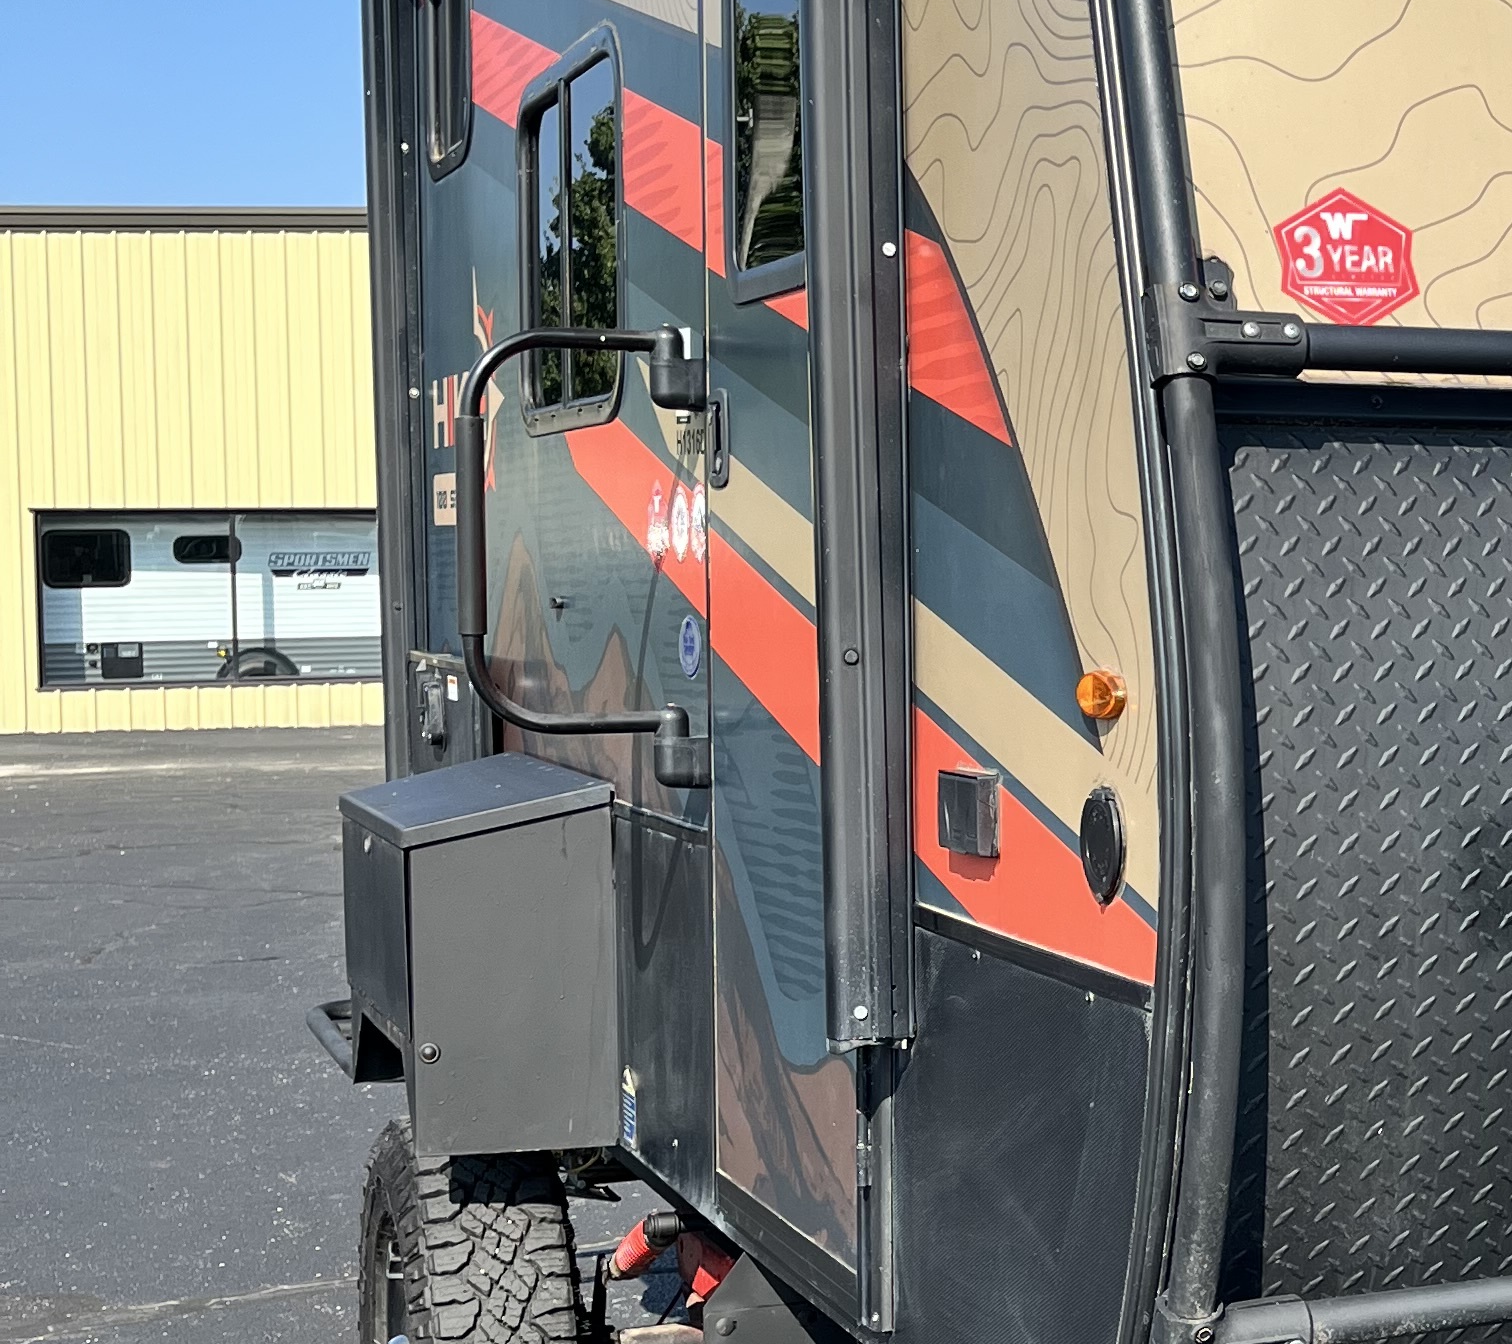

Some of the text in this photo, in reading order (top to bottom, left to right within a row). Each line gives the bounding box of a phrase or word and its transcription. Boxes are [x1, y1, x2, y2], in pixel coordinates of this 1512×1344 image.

[1293, 225, 1395, 278] 3 YEAR
[1303, 285, 1397, 297] STRUCTURAL WARRANTY
[267, 551, 370, 567] SPORTSMEN
